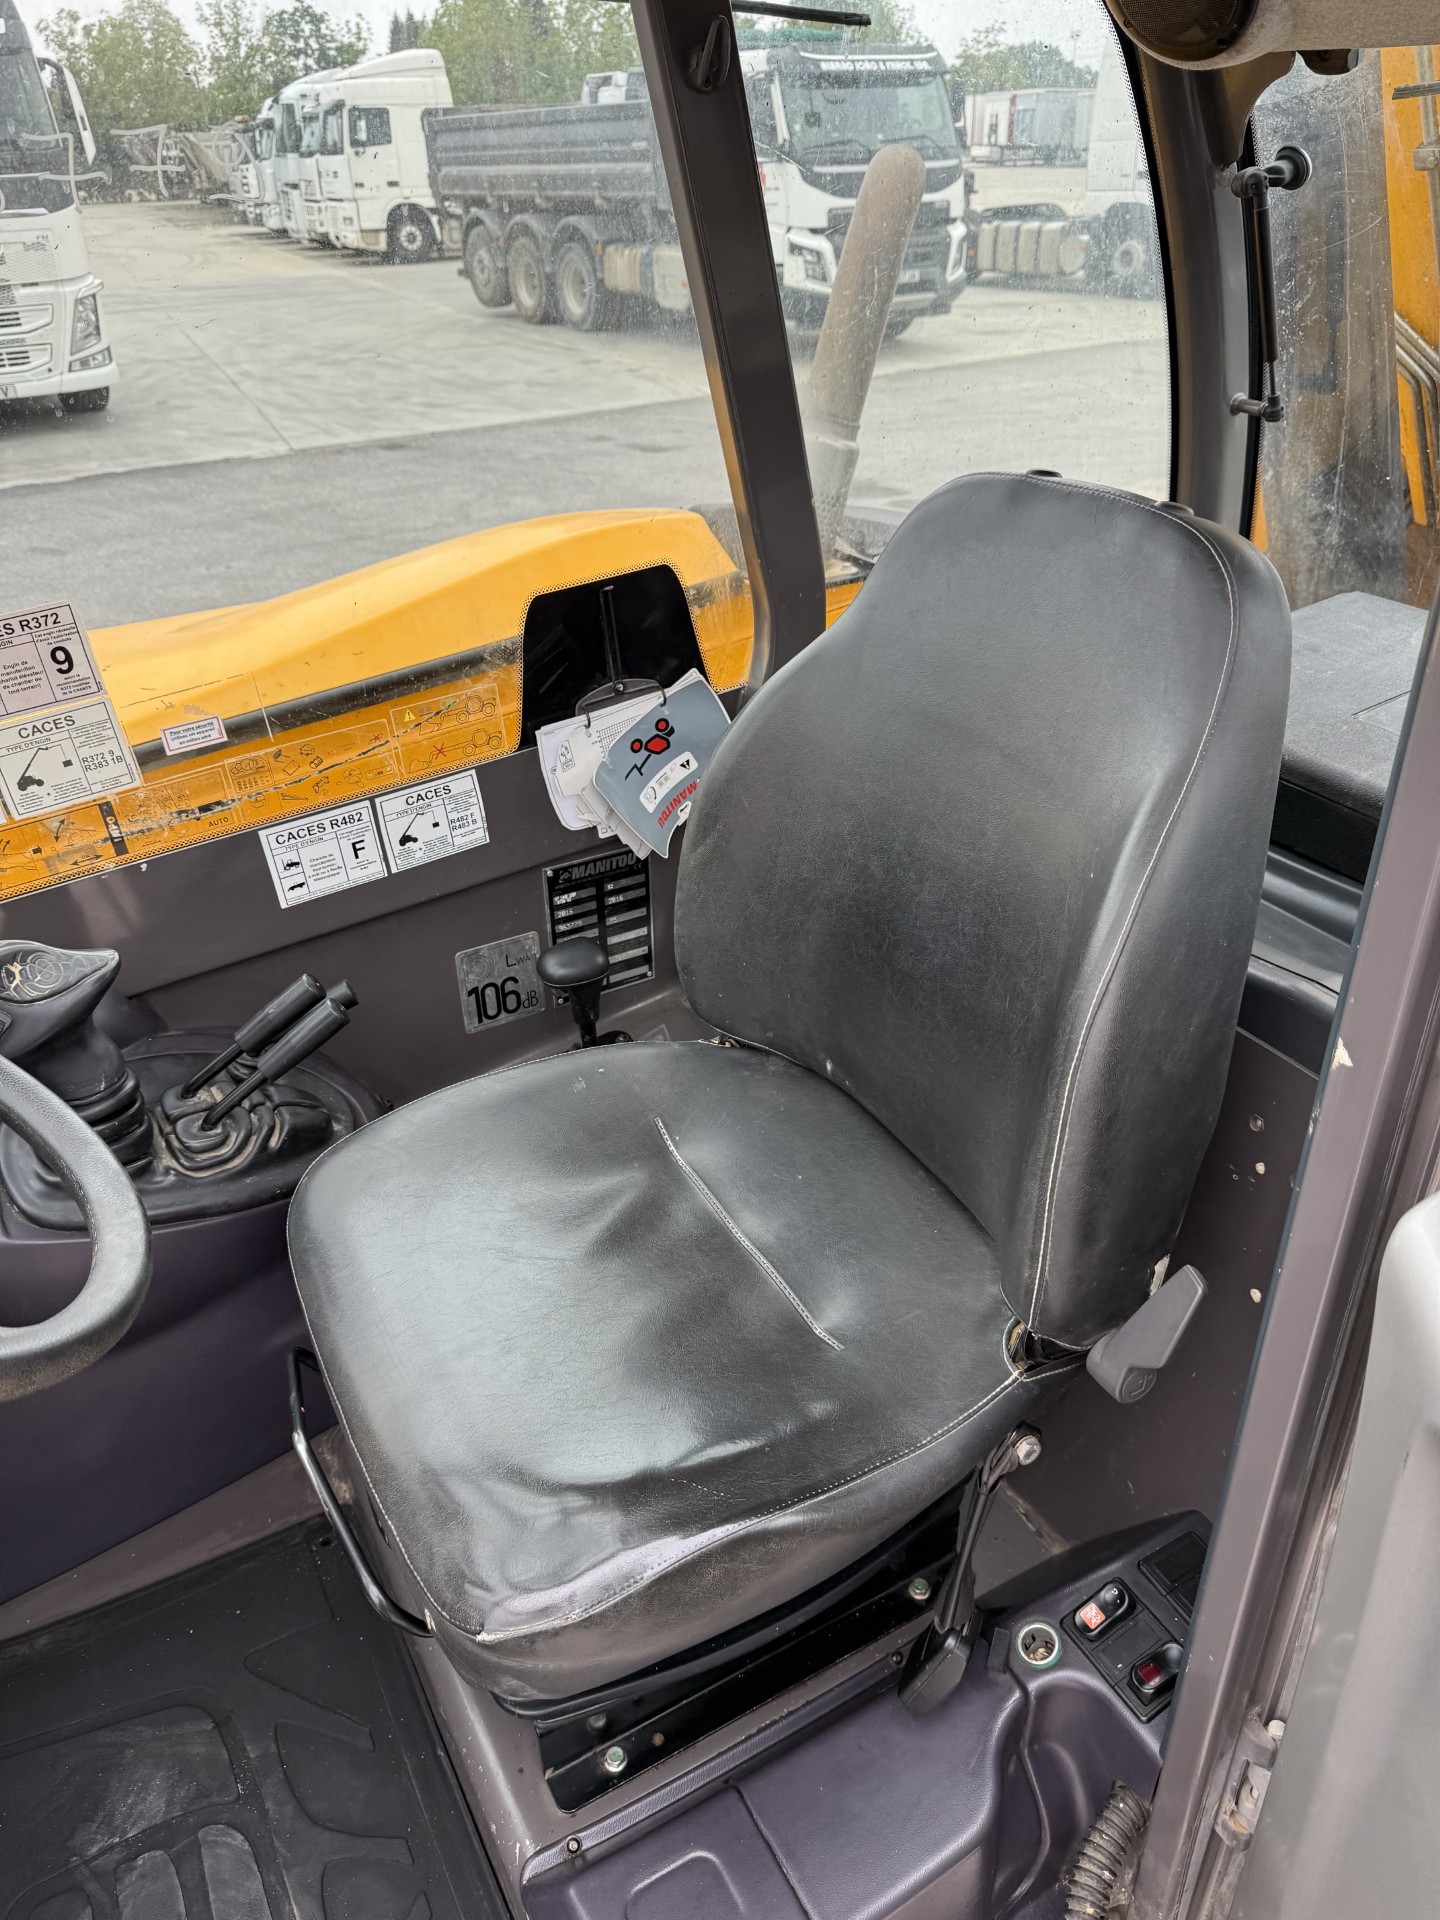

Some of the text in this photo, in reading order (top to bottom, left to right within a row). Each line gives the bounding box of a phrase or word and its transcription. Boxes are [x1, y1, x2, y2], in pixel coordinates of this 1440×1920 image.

[0, 612, 61, 637] S R372
[0, 639, 13, 648] GIN
[3, 662, 20, 670] Engin
[50, 645, 74, 675] 9
[0, 666, 35, 677] manutention
[11, 679, 34, 688] chantier
[18, 715, 76, 739] CACES
[194, 721, 213, 729] sécurité
[196, 726, 215, 735] appareil
[6, 737, 51, 753] TYPE D'ENGIN
[82, 752, 105, 765] R372
[85, 755, 124, 772] R383 1B
[406, 785, 452, 806] CACES
[657, 782, 698, 829] MANITOU
[208, 816, 229, 828] AUTO
[450, 812, 475, 826] R482 F
[276, 812, 364, 845] CACES R482
[452, 821, 471, 832] R483
[351, 839, 368, 859] F
[572, 852, 636, 880] MANITOU
[608, 894, 624, 905] 2016
[557, 909, 574, 918] 2016
[468, 976, 539, 1024] 106 dB
